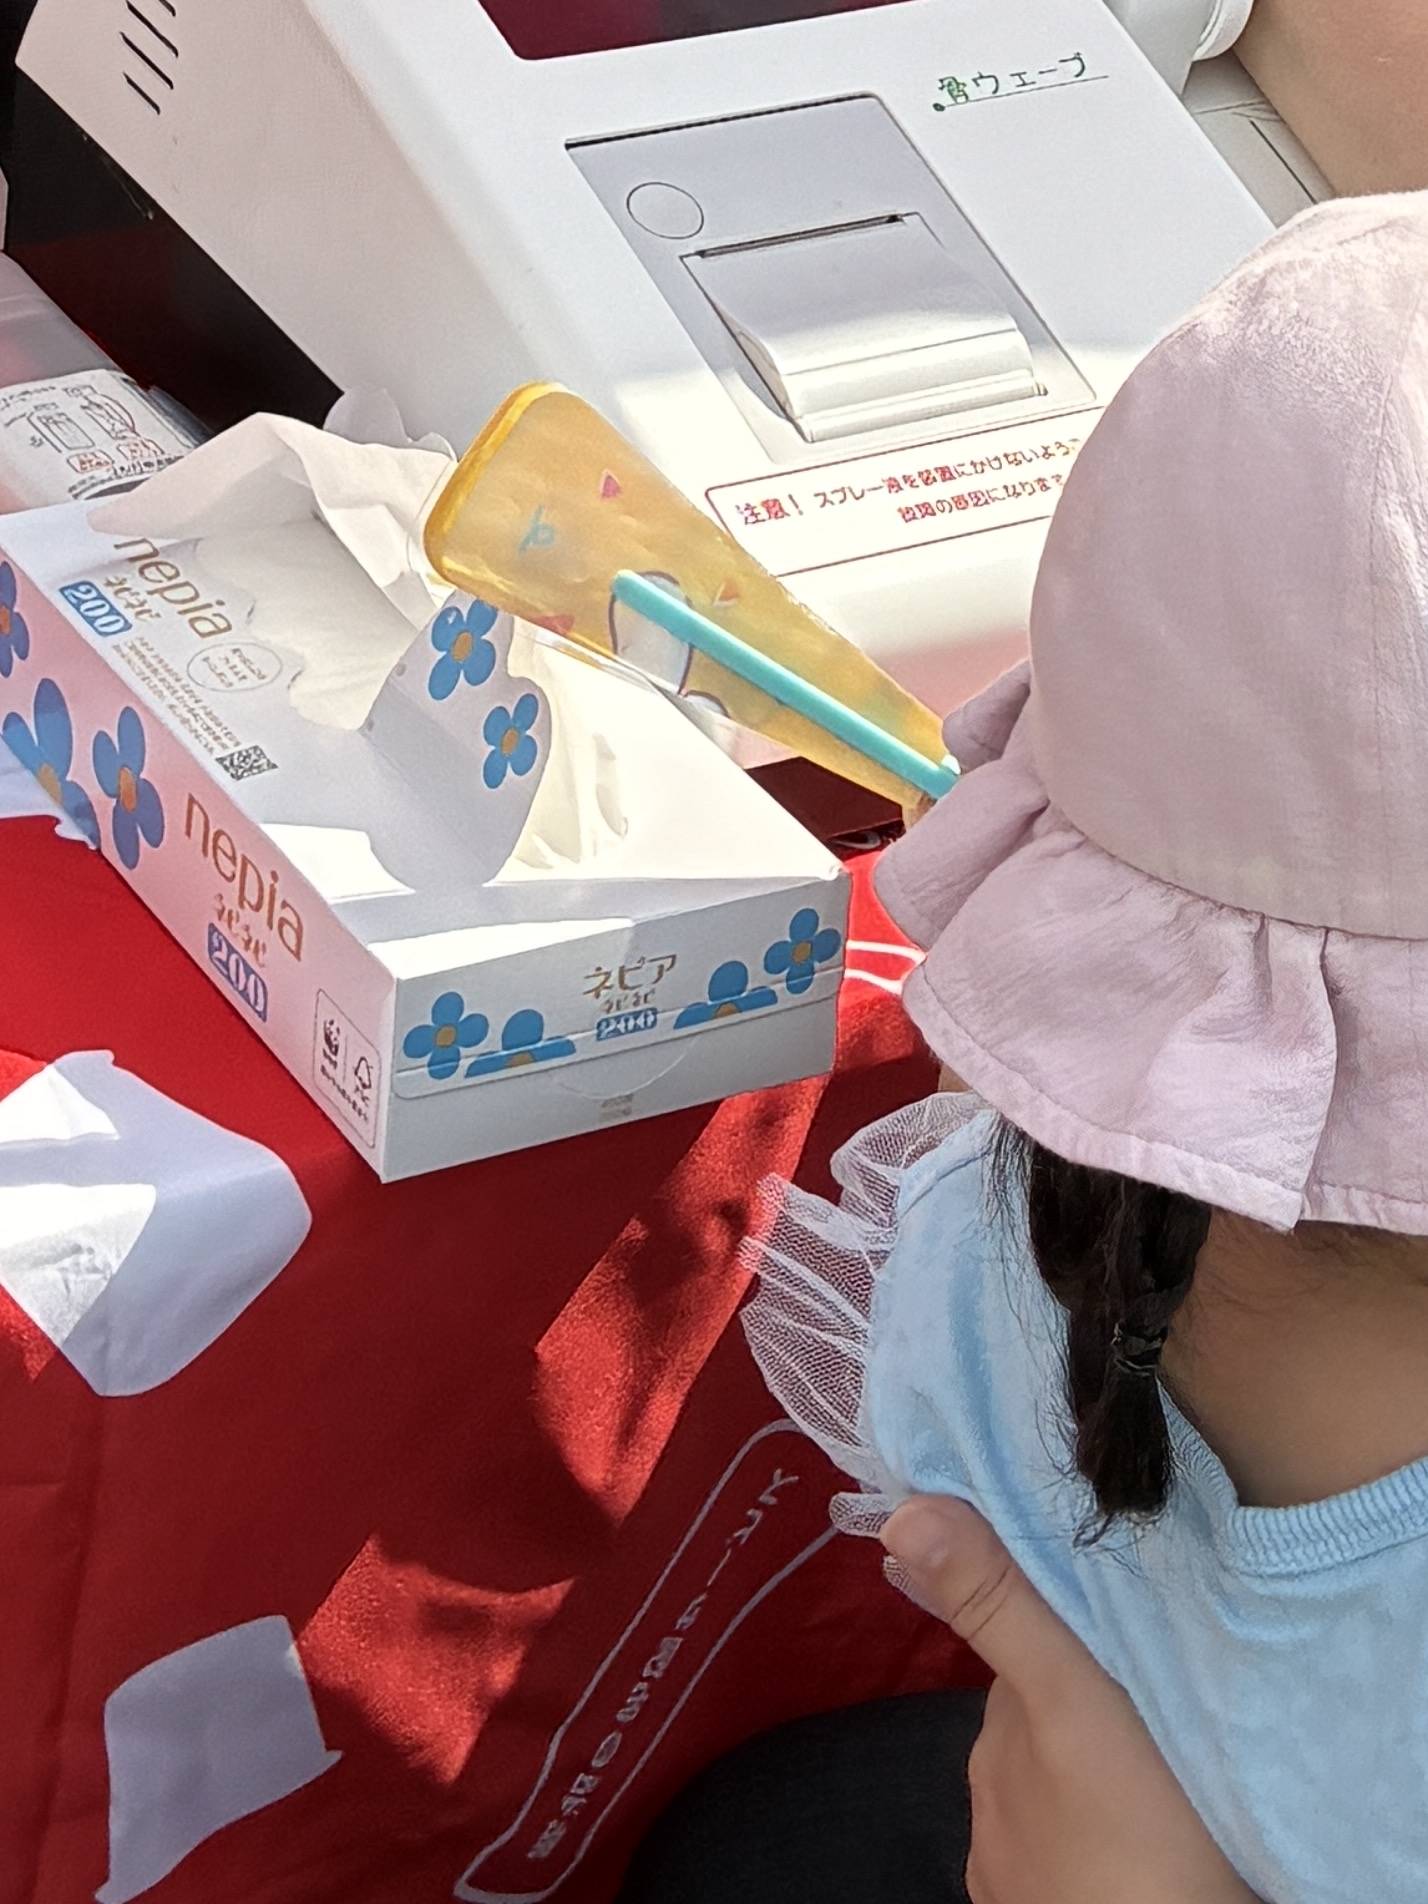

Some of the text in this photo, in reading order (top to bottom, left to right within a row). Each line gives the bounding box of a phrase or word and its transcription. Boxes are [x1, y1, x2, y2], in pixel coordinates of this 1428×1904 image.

[67, 583, 126, 635] 200
[113, 538, 232, 639] nepia
[185, 792, 304, 962] nepia
[210, 932, 266, 1017] 200
[583, 954, 676, 999] ネピア
[599, 1010, 654, 1039] 200
